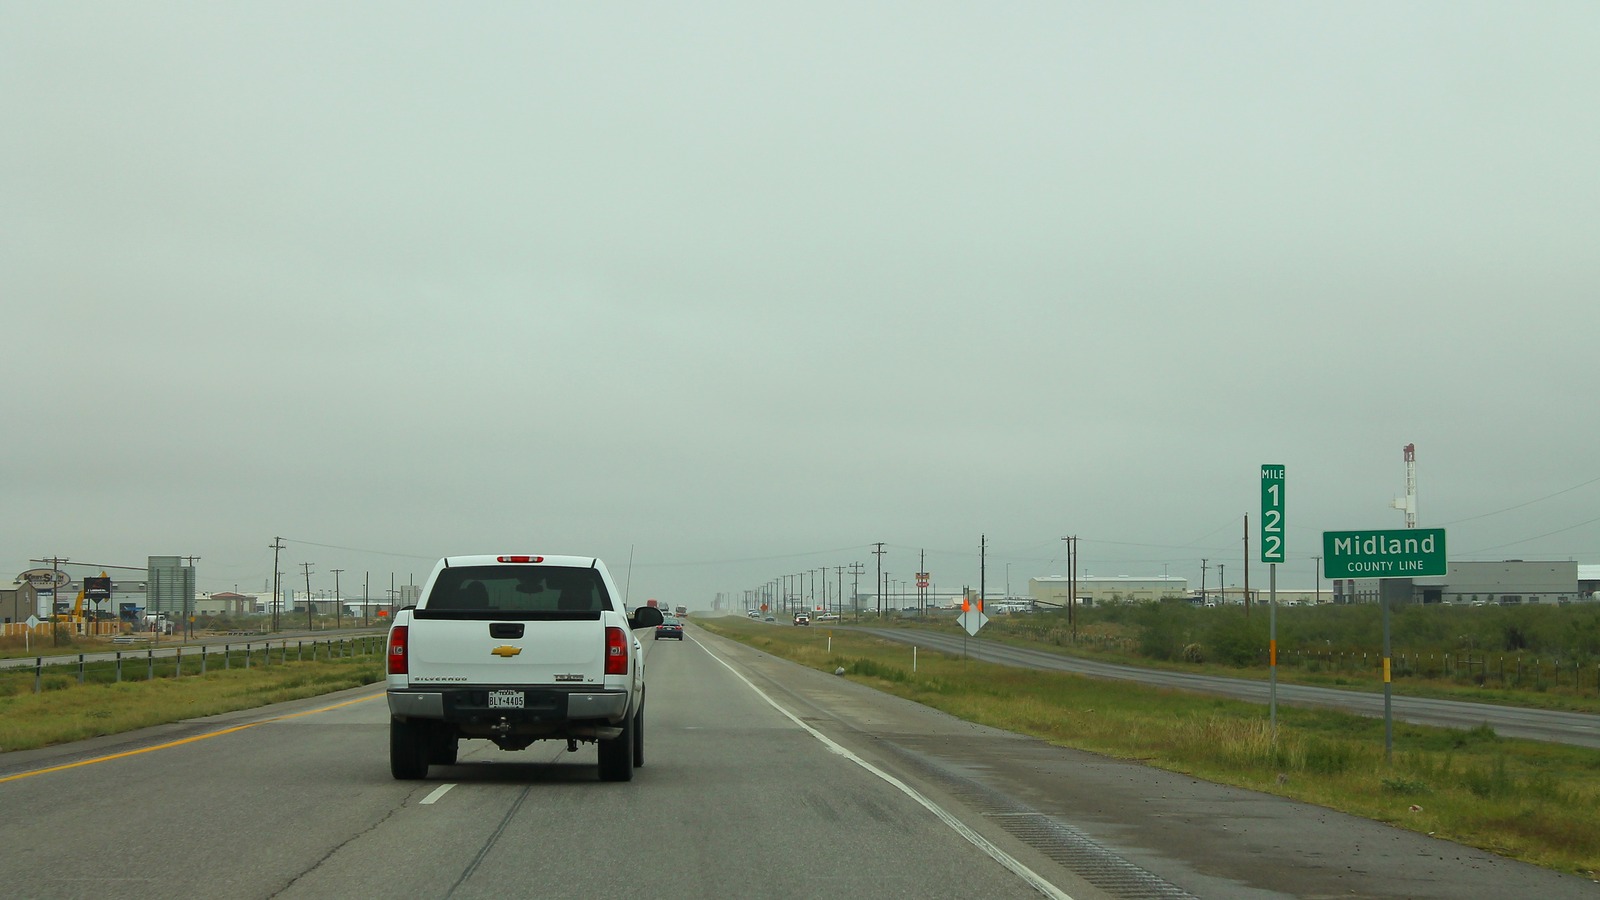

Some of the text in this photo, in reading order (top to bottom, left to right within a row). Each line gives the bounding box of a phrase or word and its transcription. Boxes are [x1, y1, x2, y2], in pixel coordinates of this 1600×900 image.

[1262, 470, 1284, 479] MILE
[1265, 484, 1281, 558] 122
[1334, 534, 1435, 556] Midland
[1347, 560, 1424, 572] COUNTY LINE
